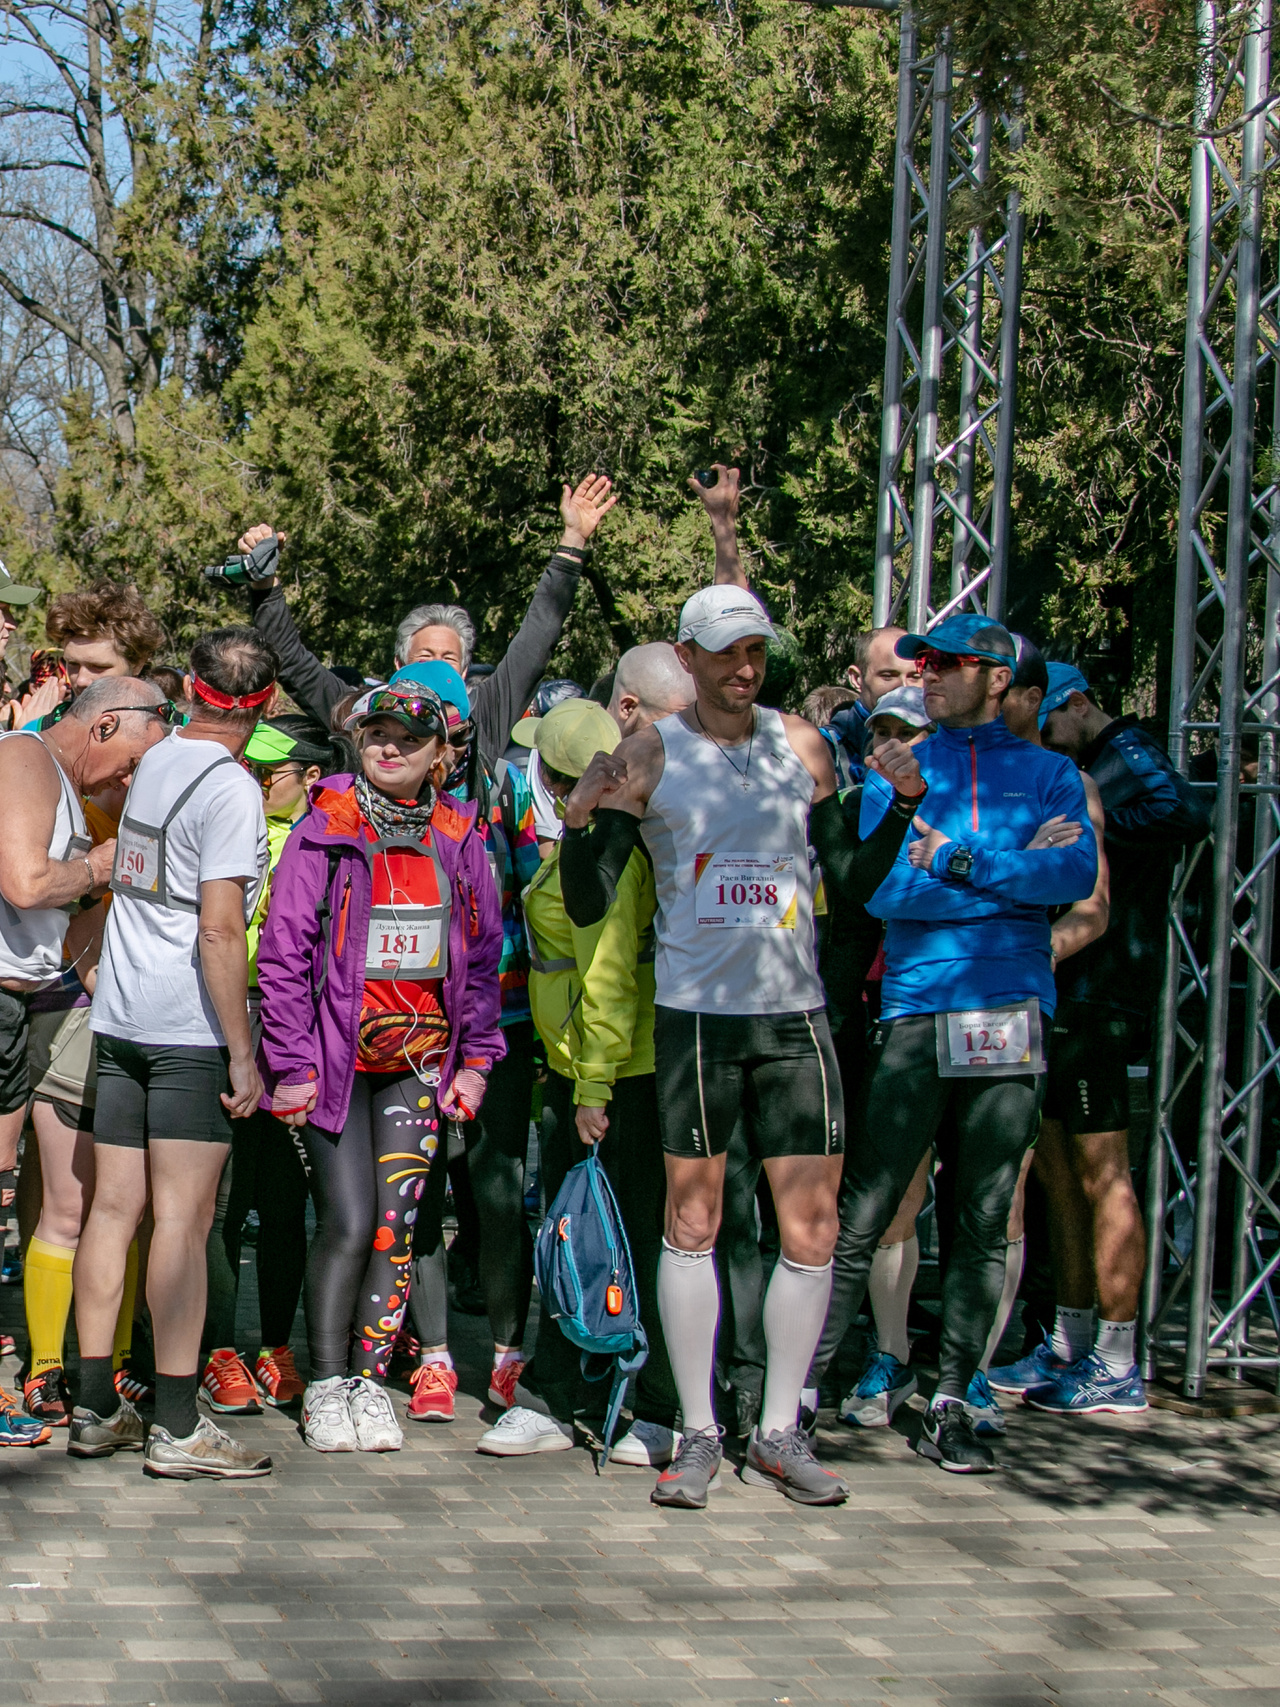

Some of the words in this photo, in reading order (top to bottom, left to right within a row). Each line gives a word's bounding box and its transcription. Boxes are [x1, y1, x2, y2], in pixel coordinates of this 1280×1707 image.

[120, 848, 144, 874] 150
[740, 874, 775, 882] Виталий
[715, 883, 778, 905] 1038
[378, 933, 420, 954] 181
[963, 1029, 1008, 1052] 123
